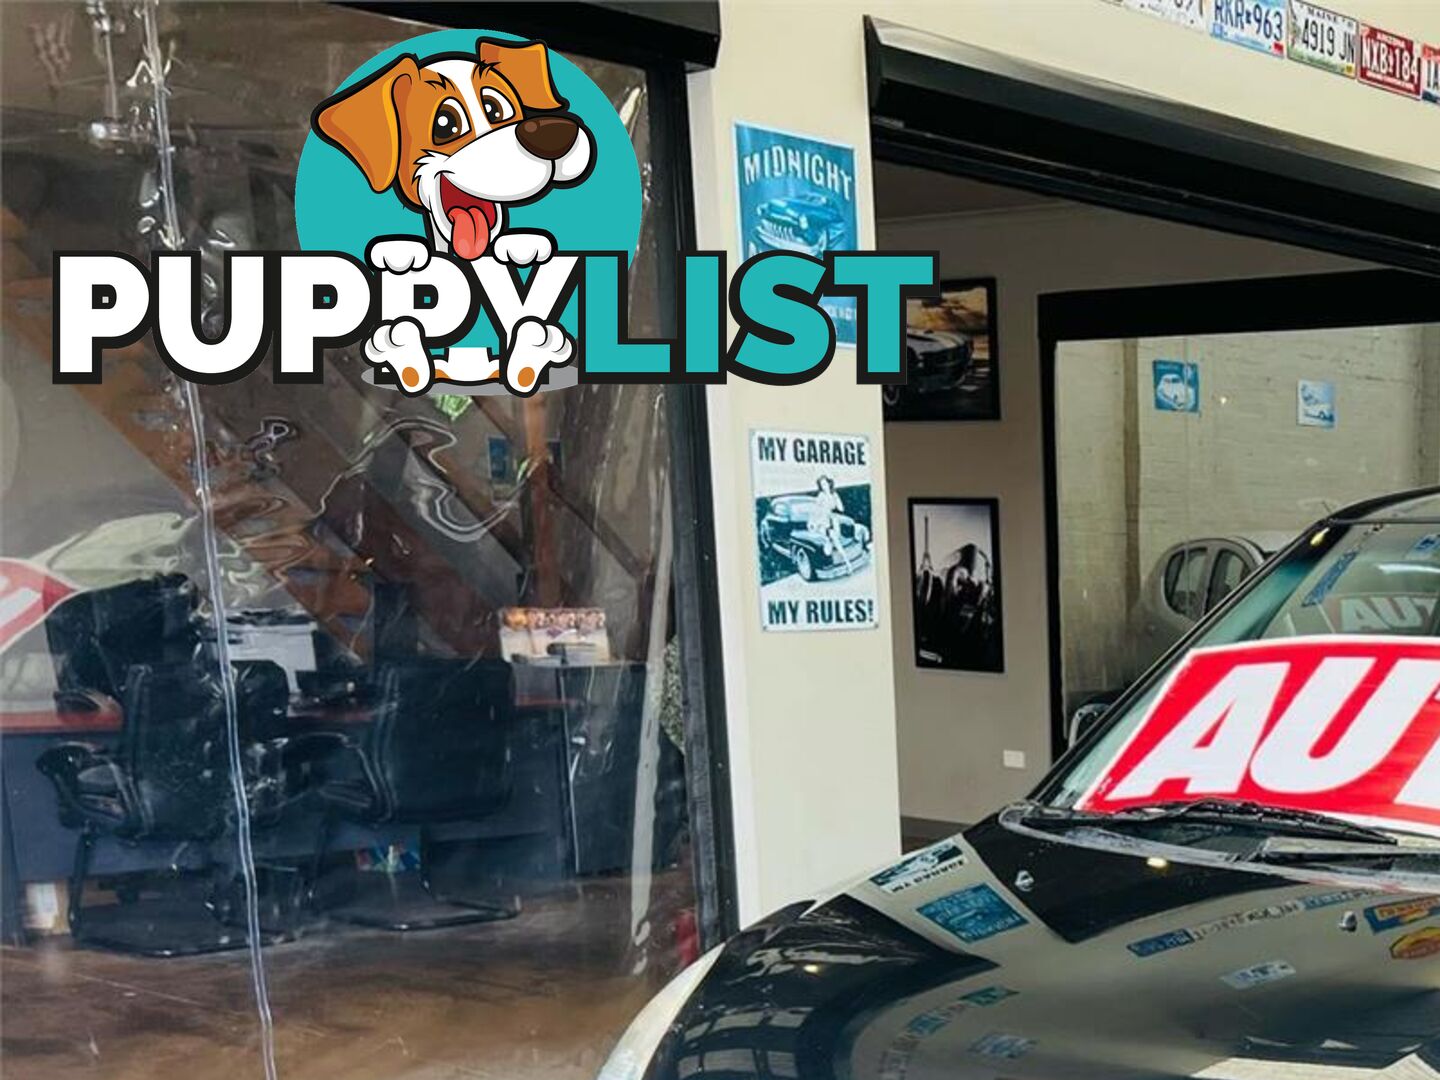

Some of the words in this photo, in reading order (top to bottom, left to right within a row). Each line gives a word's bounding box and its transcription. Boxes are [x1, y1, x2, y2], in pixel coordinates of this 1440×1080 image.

[1302, 18, 1335, 56] 4919
[743, 145, 852, 200] MIDNIGHT
[757, 436, 787, 462] MY
[793, 438, 867, 466] GARAGE
[768, 600, 799, 625] MY
[806, 598, 874, 624] RULES!
